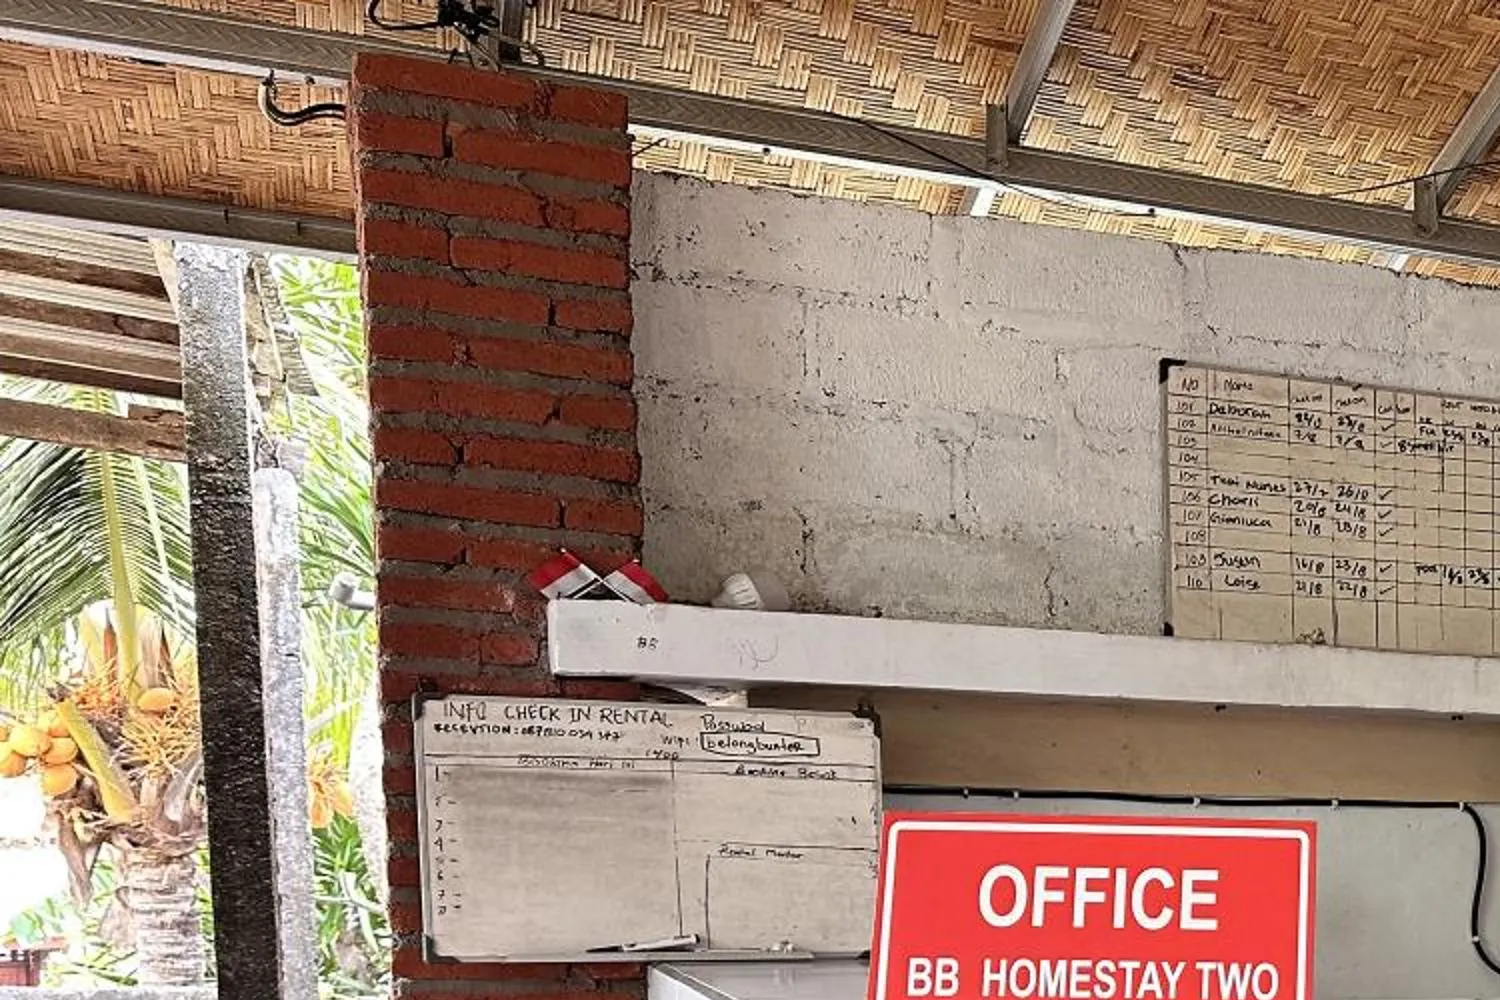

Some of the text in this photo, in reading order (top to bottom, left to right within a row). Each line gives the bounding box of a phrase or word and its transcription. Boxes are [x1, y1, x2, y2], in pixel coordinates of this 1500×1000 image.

[444, 701, 487, 723] INFO
[504, 703, 561, 722] CHECK
[570, 706, 591, 723] IN
[978, 864, 1220, 932] OFFICE
[906, 957, 960, 998] BB
[980, 958, 1188, 1000] HOMESTAY
